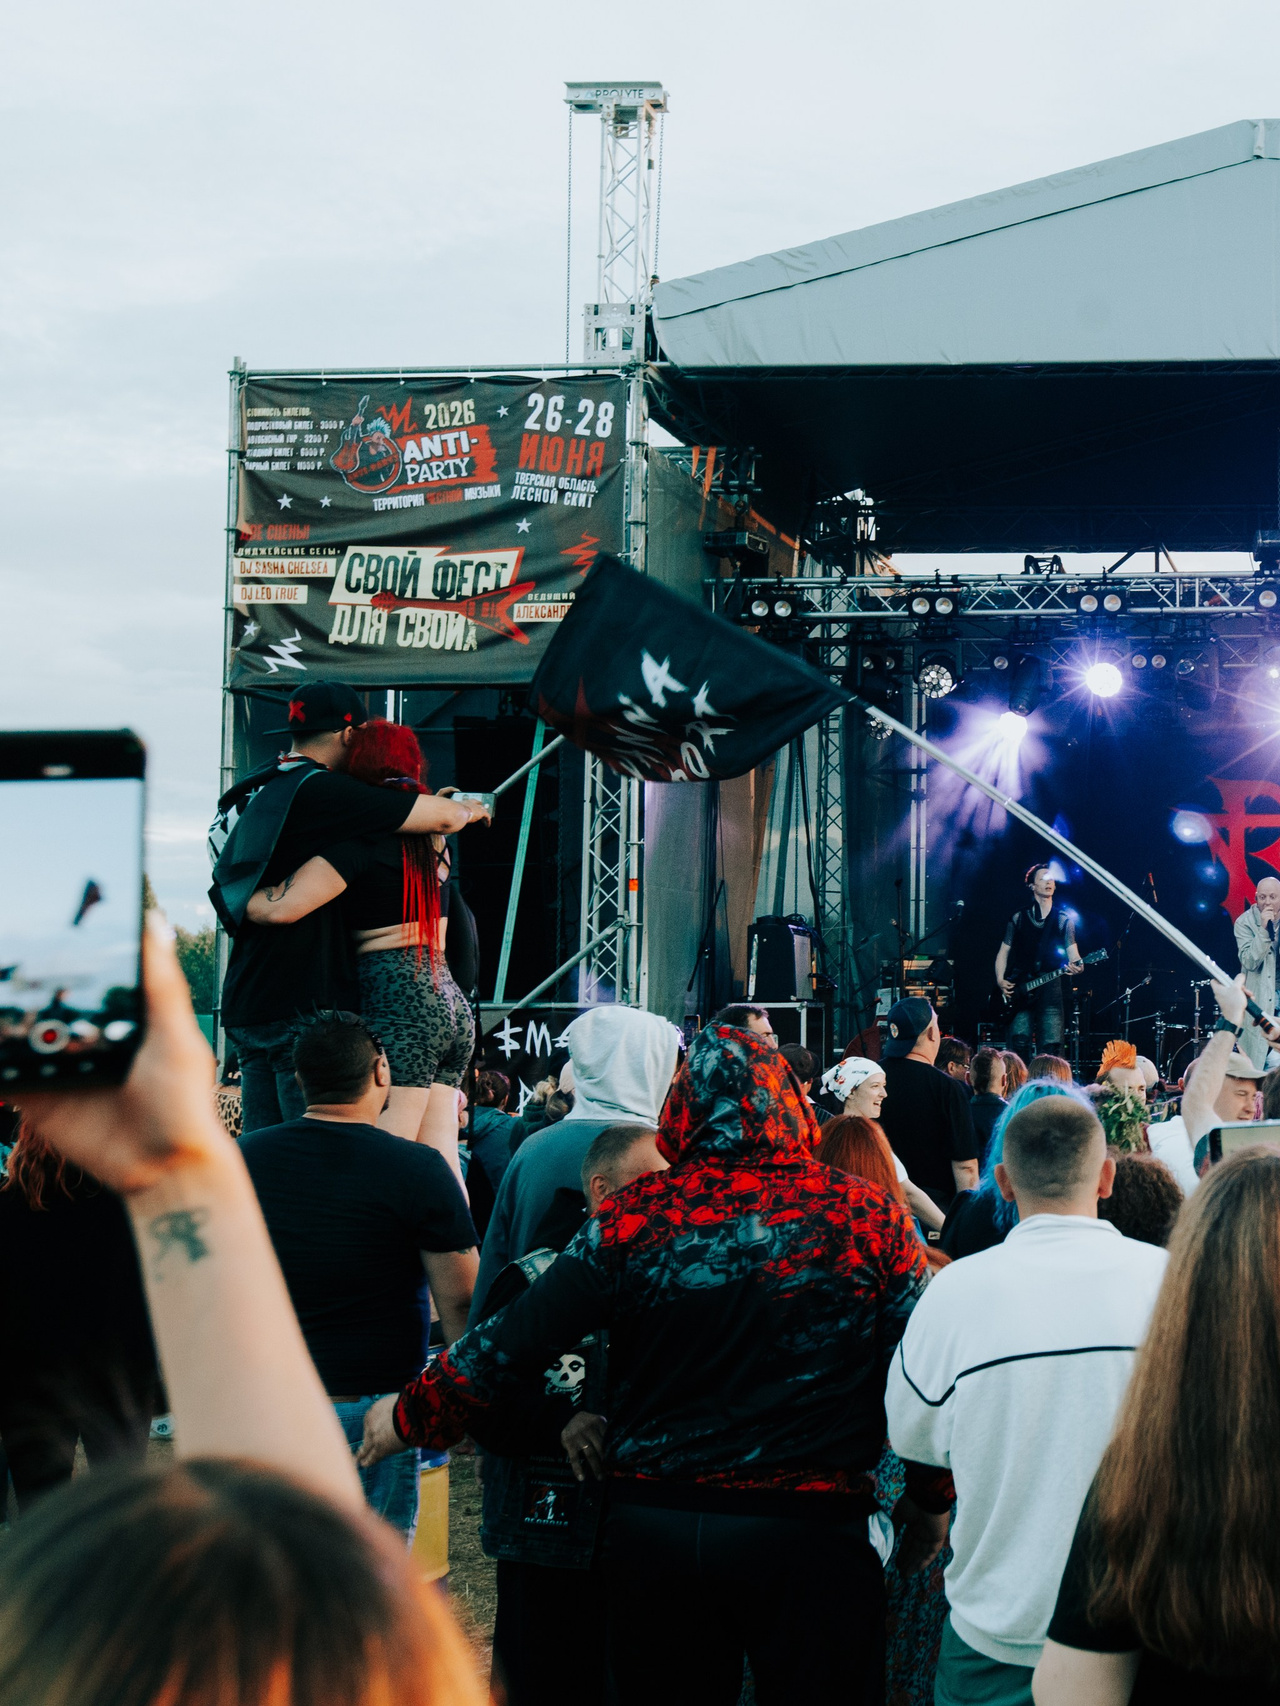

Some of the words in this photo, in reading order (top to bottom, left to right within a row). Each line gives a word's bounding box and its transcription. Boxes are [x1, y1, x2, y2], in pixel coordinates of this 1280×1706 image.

[424, 398, 476, 430] 2026
[524, 393, 615, 438] 26-28
[294, 421, 314, 430] БИЛЕТ
[339, 421, 346, 429] Р.
[286, 434, 297, 443] ТУР
[304, 434, 322, 443] 3200
[323, 434, 330, 443] Р.
[403, 430, 479, 464] ANTI-
[274, 448, 294, 457] БИЛЕТ
[319, 448, 326, 457] Р.
[518, 433, 606, 477] ИЮНЯ
[271, 462, 291, 471] БИЛЕТ
[317, 462, 324, 470] Р.
[405, 457, 470, 485] PARTY
[515, 472, 556, 488] ТВЕРСКАЯ
[373, 493, 425, 511] ТЕРРИТОРИЯ
[464, 484, 501, 501] МУЗЫКИ
[511, 485, 558, 504] ЛЕСНОЙ
[563, 492, 594, 508] СКИТ
[237, 547, 306, 557] ДИДЖЕЙСКИЕ
[240, 561, 252, 574] DJ
[255, 561, 285, 575] SASHA
[287, 561, 328, 575] CHELSEA
[344, 550, 421, 598] СВОЙ
[432, 559, 509, 600] ФЕСТ
[241, 587, 253, 600] DJ
[255, 587, 272, 600] LEO
[275, 587, 299, 600] TRUE
[527, 592, 576, 601] ВЕДУЩИЙ
[328, 605, 388, 645] ДЛЯ
[396, 610, 478, 651] СВОИХ
